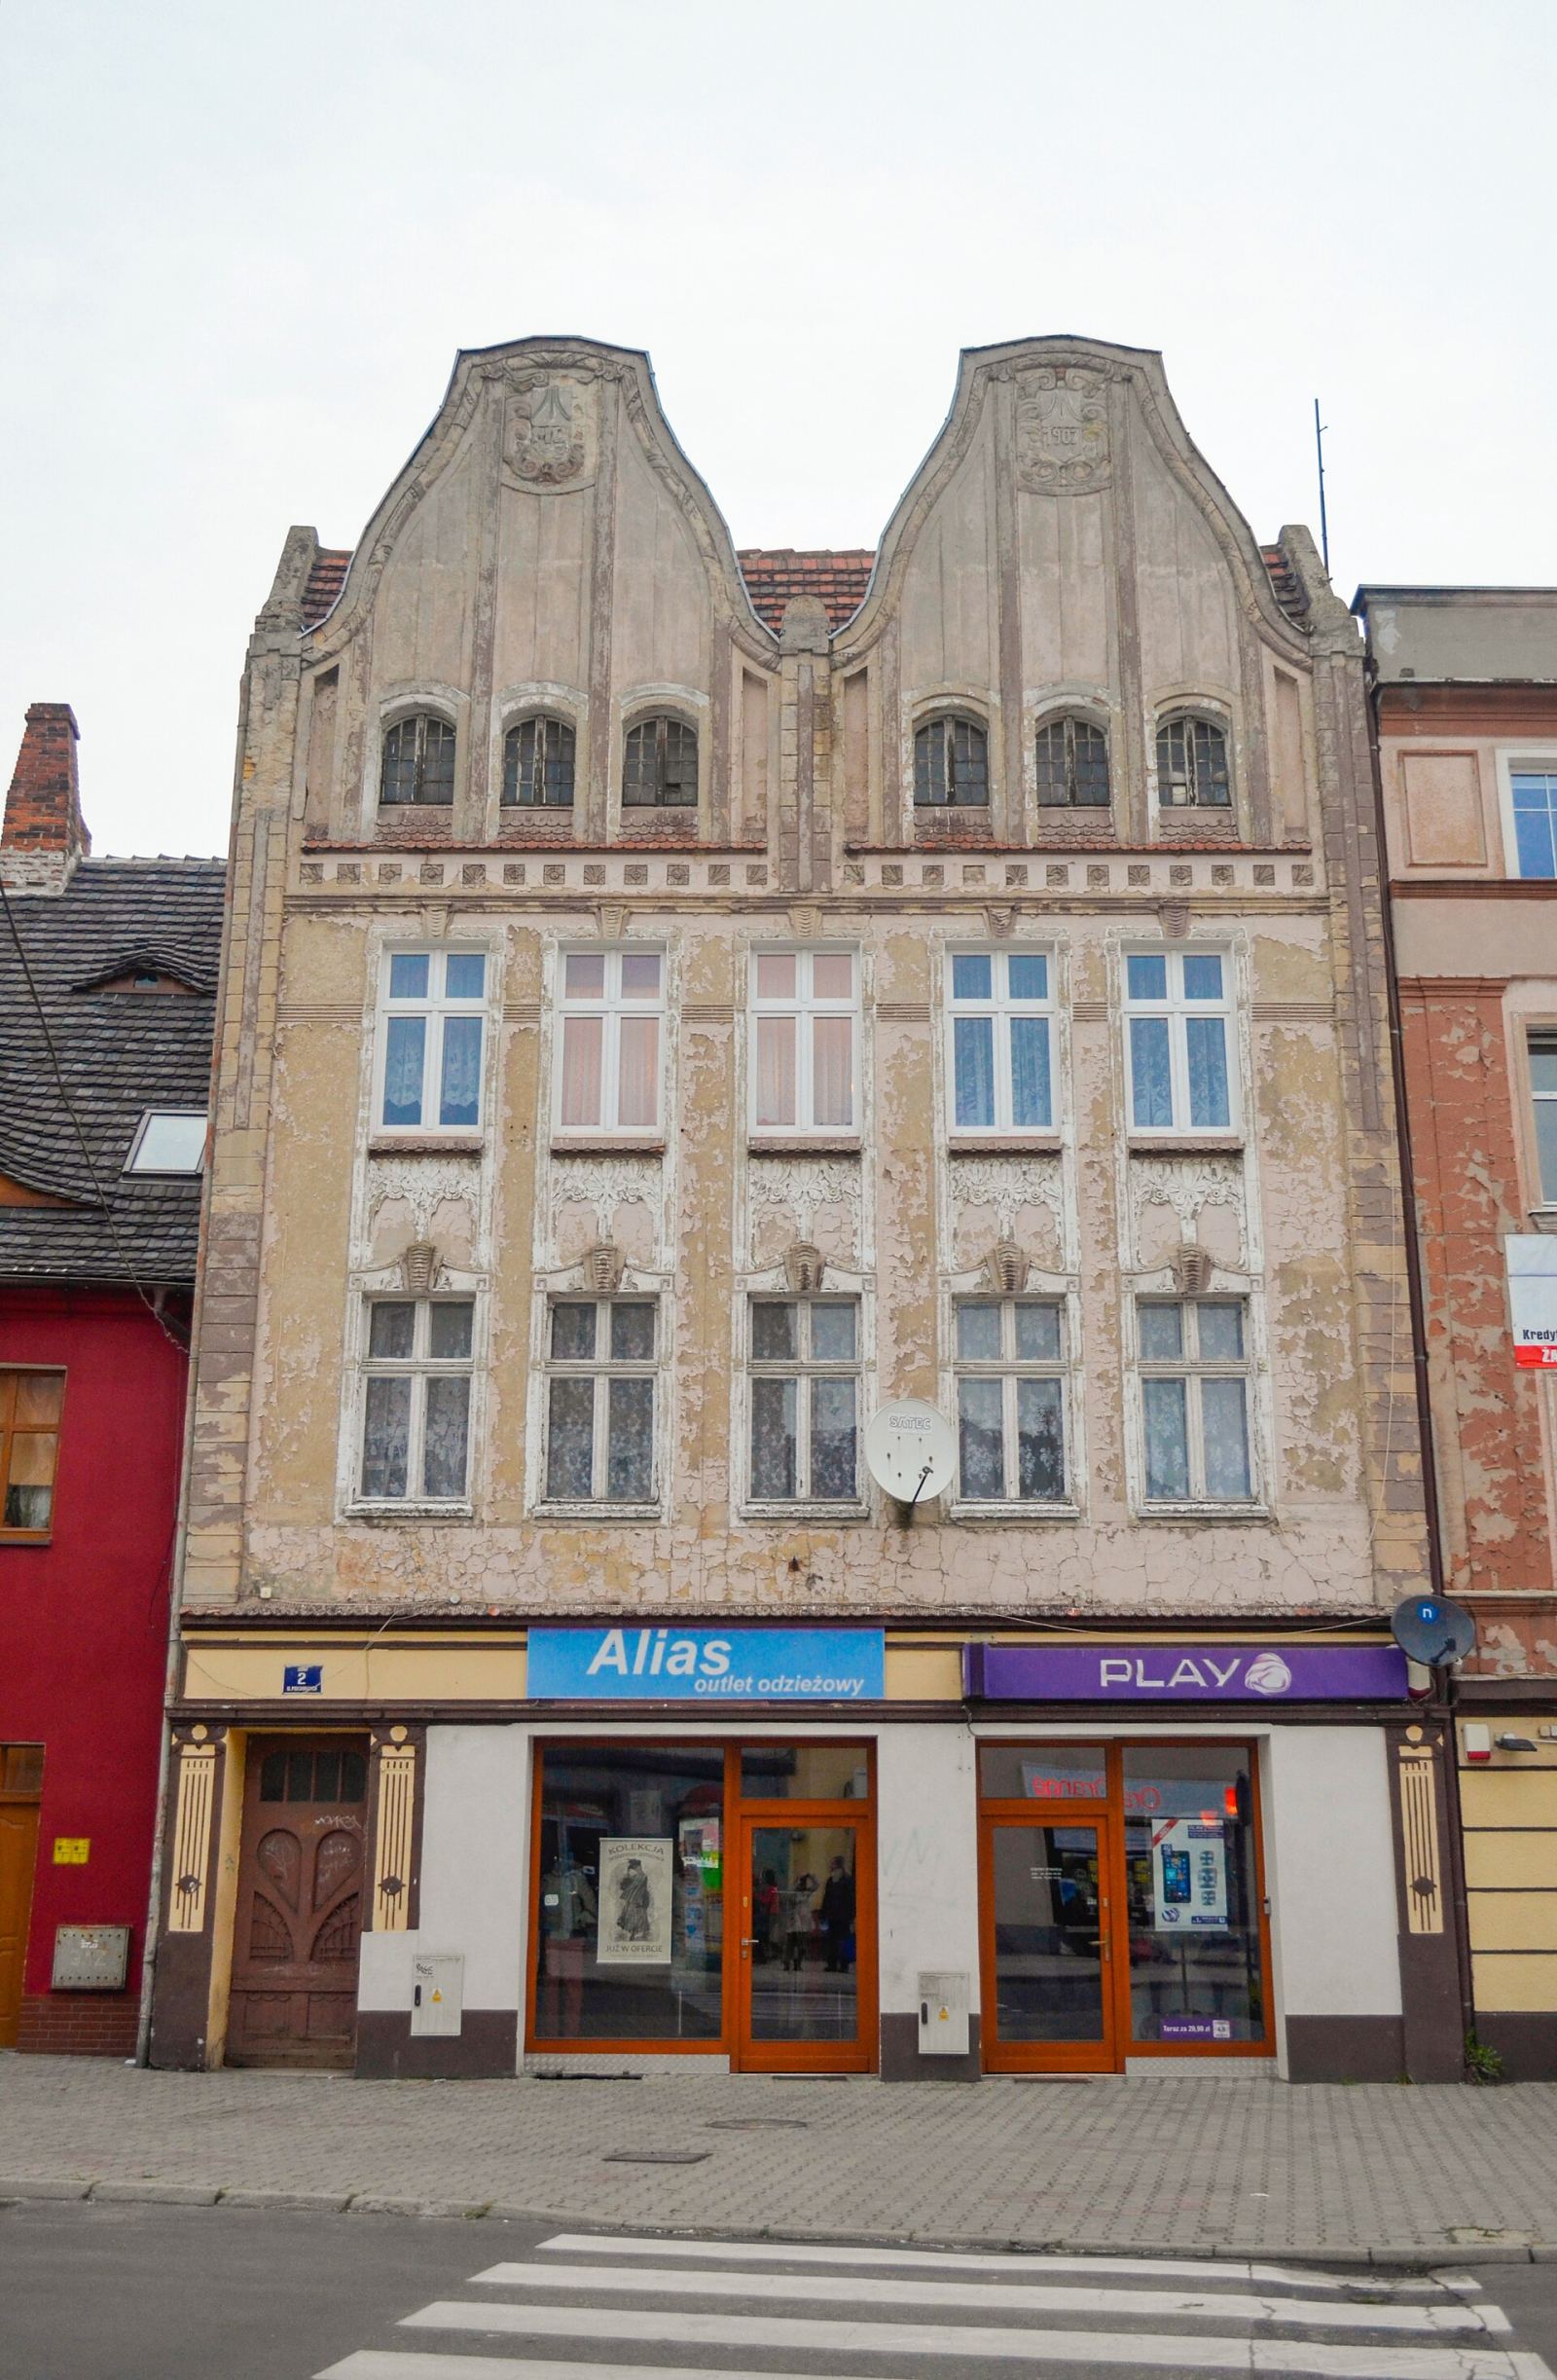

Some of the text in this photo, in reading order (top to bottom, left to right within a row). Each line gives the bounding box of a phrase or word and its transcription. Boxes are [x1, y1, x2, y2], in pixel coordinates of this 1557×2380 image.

[1522, 1330, 1557, 1341] Kredy
[888, 1415, 931, 1430] SATEC
[1422, 1607, 1432, 1619] n
[586, 1629, 732, 1675] Alias
[297, 1672, 307, 1685] 2
[1100, 1658, 1242, 1688] PLAY
[694, 1674, 864, 1697] outlet odzieżowy
[607, 1843, 665, 1855] KOLEKCJA
